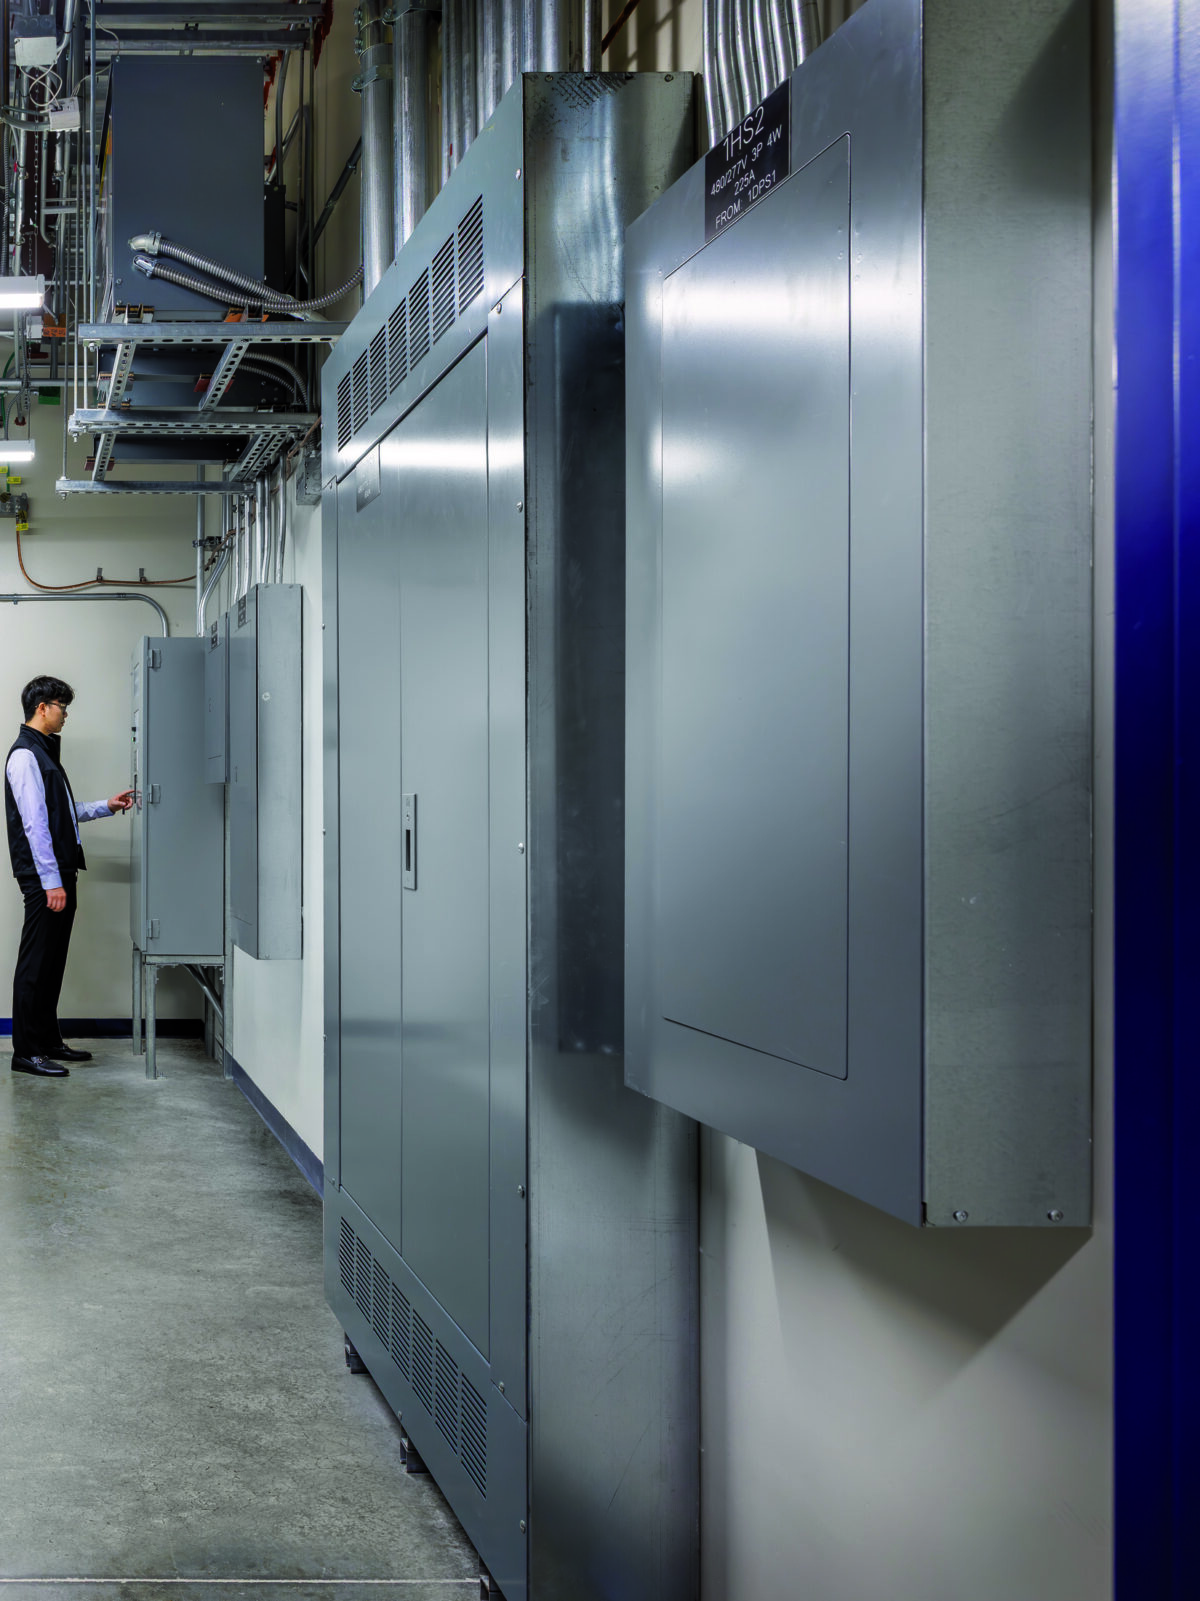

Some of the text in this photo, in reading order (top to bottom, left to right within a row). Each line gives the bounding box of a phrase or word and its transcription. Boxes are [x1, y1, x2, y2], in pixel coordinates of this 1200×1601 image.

[723, 105, 765, 161] 1HS2
[710, 124, 783, 196] 480/277V 3P 4W
[734, 169, 756, 196] 225A
[748, 169, 776, 202] 1DPS1
